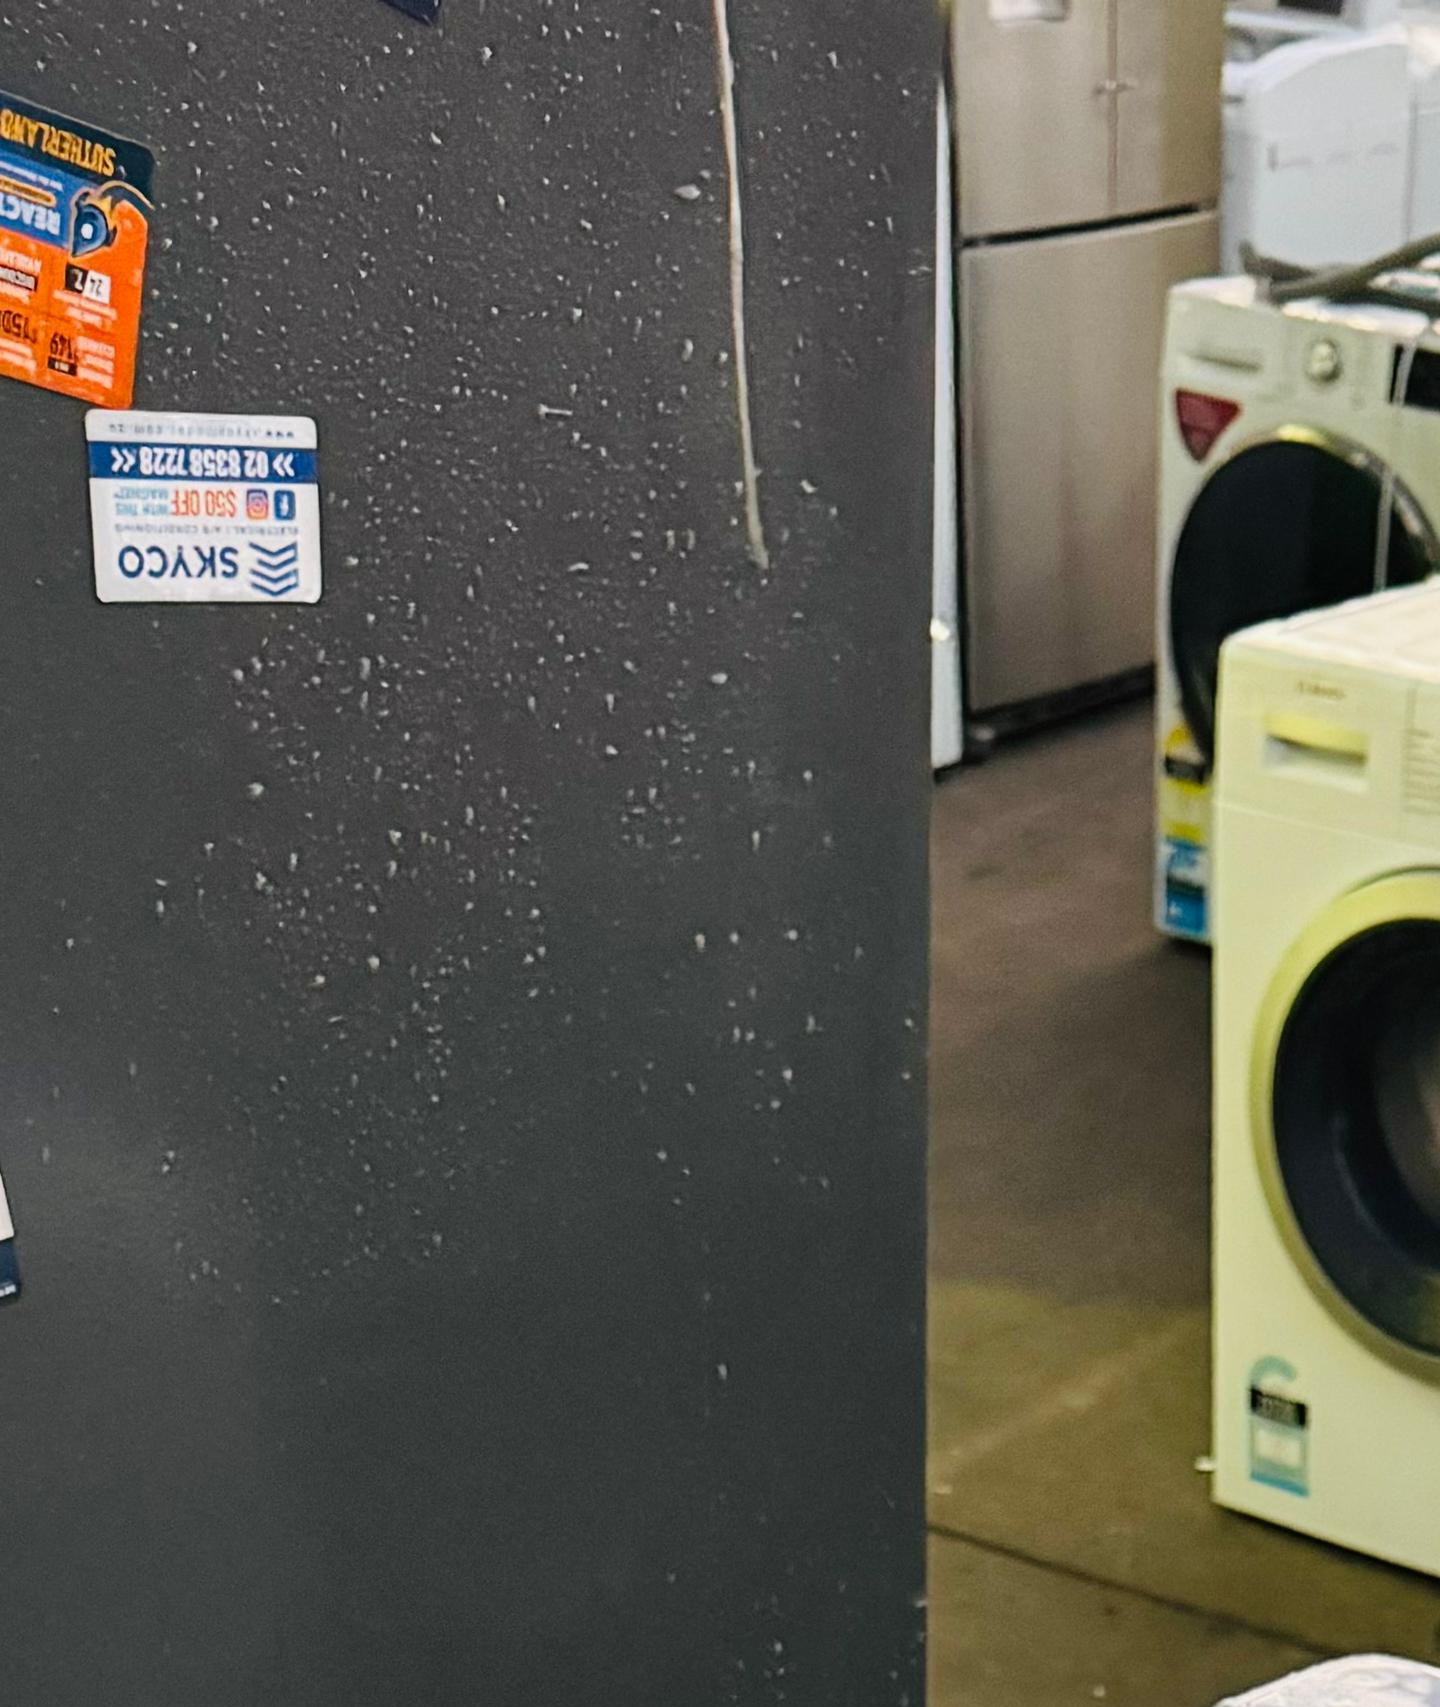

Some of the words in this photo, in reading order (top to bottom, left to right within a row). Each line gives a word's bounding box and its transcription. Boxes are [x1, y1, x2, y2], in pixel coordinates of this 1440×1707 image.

[0, 107, 115, 176] SUTHERLAND
[139, 447, 186, 474] 7228
[188, 449, 241, 476] 8358
[244, 451, 268, 477] 02
[170, 490, 200, 515] OFF
[205, 490, 236, 518] $50
[118, 545, 239, 579] SKYCO
